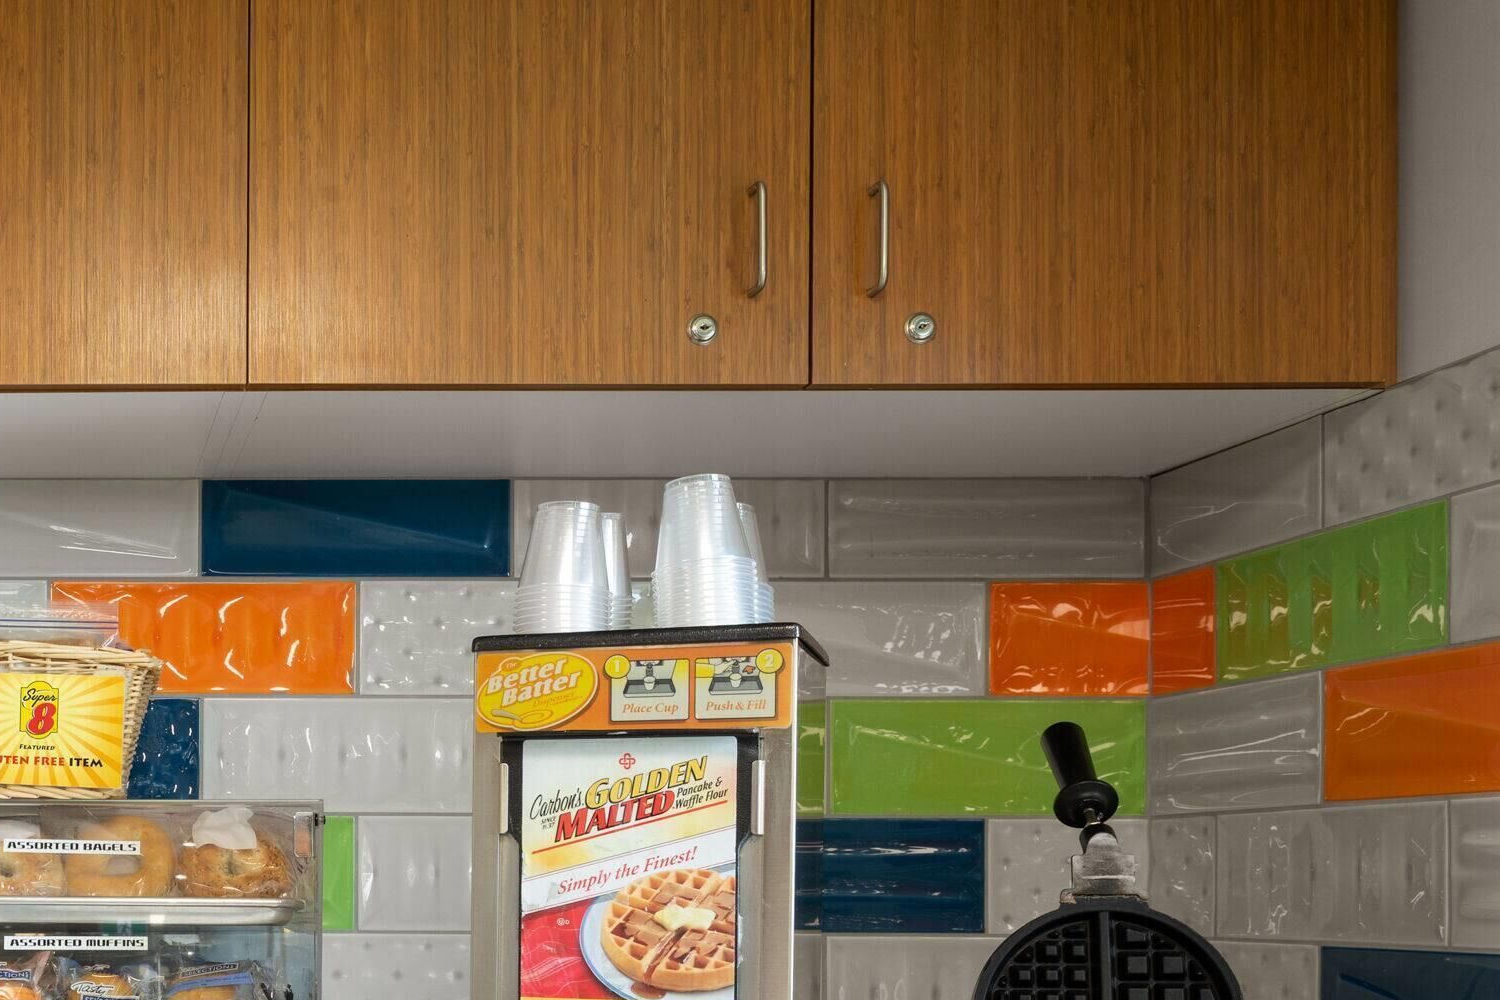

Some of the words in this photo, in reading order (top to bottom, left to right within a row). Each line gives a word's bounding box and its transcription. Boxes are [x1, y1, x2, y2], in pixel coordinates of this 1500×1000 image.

[613, 660, 621, 673] 1
[764, 653, 774, 668] 2
[486, 657, 568, 695] Better
[22, 687, 57, 708] Super
[501, 671, 581, 707] Batter
[622, 702, 652, 714] Place
[655, 702, 679, 715] Cup
[706, 700, 733, 712] Push
[735, 701, 745, 710] &
[747, 698, 767, 711] Fill
[26, 702, 57, 735] 8
[19, 743, 56, 751] FEATURED
[34, 756, 65, 767] FREE
[69, 757, 103, 768] ITEM
[585, 755, 708, 810] GOLDEN
[676, 780, 713, 798] Pancake
[715, 776, 723, 788] &
[529, 788, 583, 820] Carbon's
[675, 793, 702, 811] Waffle
[706, 787, 729, 802] Flour
[554, 790, 676, 843] MALTED
[7, 841, 79, 851] ASSORTED
[83, 843, 137, 852] BAGELS
[557, 870, 611, 895] Simply
[615, 864, 640, 881] the
[643, 846, 698, 873] Finest!
[10, 939, 82, 947] ASSORTED
[86, 939, 145, 947] MUFFINS
[71, 981, 115, 995] Tasty
